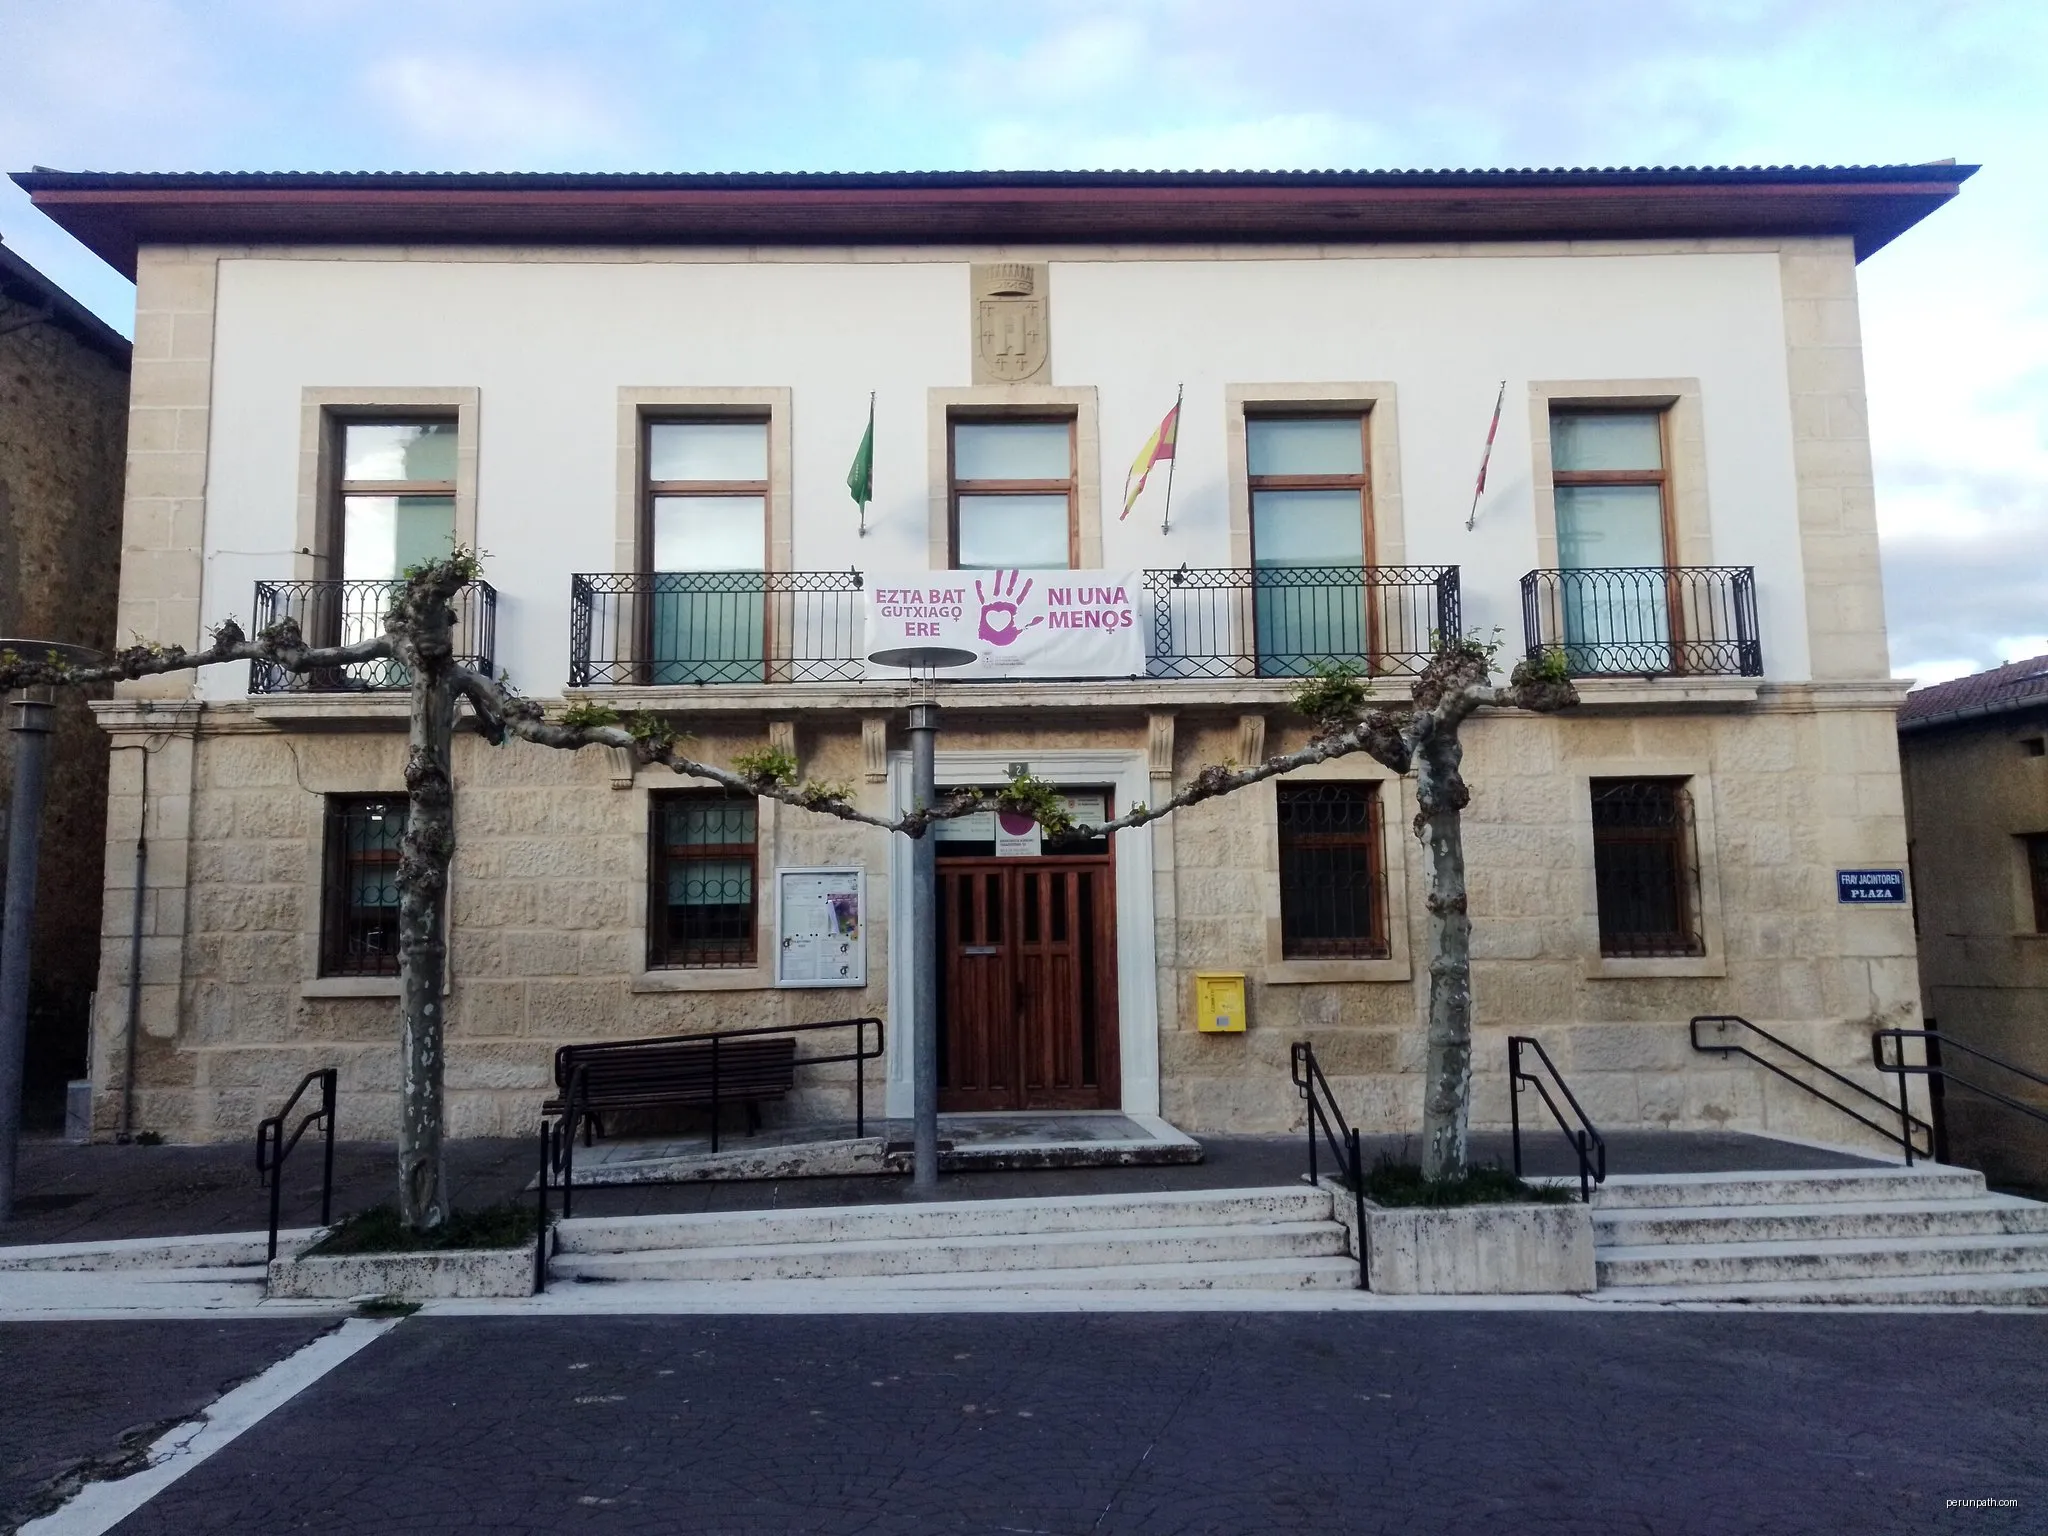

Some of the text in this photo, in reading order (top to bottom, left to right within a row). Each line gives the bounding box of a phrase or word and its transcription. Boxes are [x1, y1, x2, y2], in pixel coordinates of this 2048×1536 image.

[876, 589, 966, 604] EZTA BAT
[1048, 586, 1130, 606] NI UNA
[881, 606, 963, 621] GUTXIAGO
[1048, 609, 1133, 633] MENOS
[905, 622, 941, 637] ERE
[1016, 765, 1022, 776] 2
[1841, 874, 1900, 885] FRAY JACINTOREN
[1851, 890, 1893, 898] PLAZA
